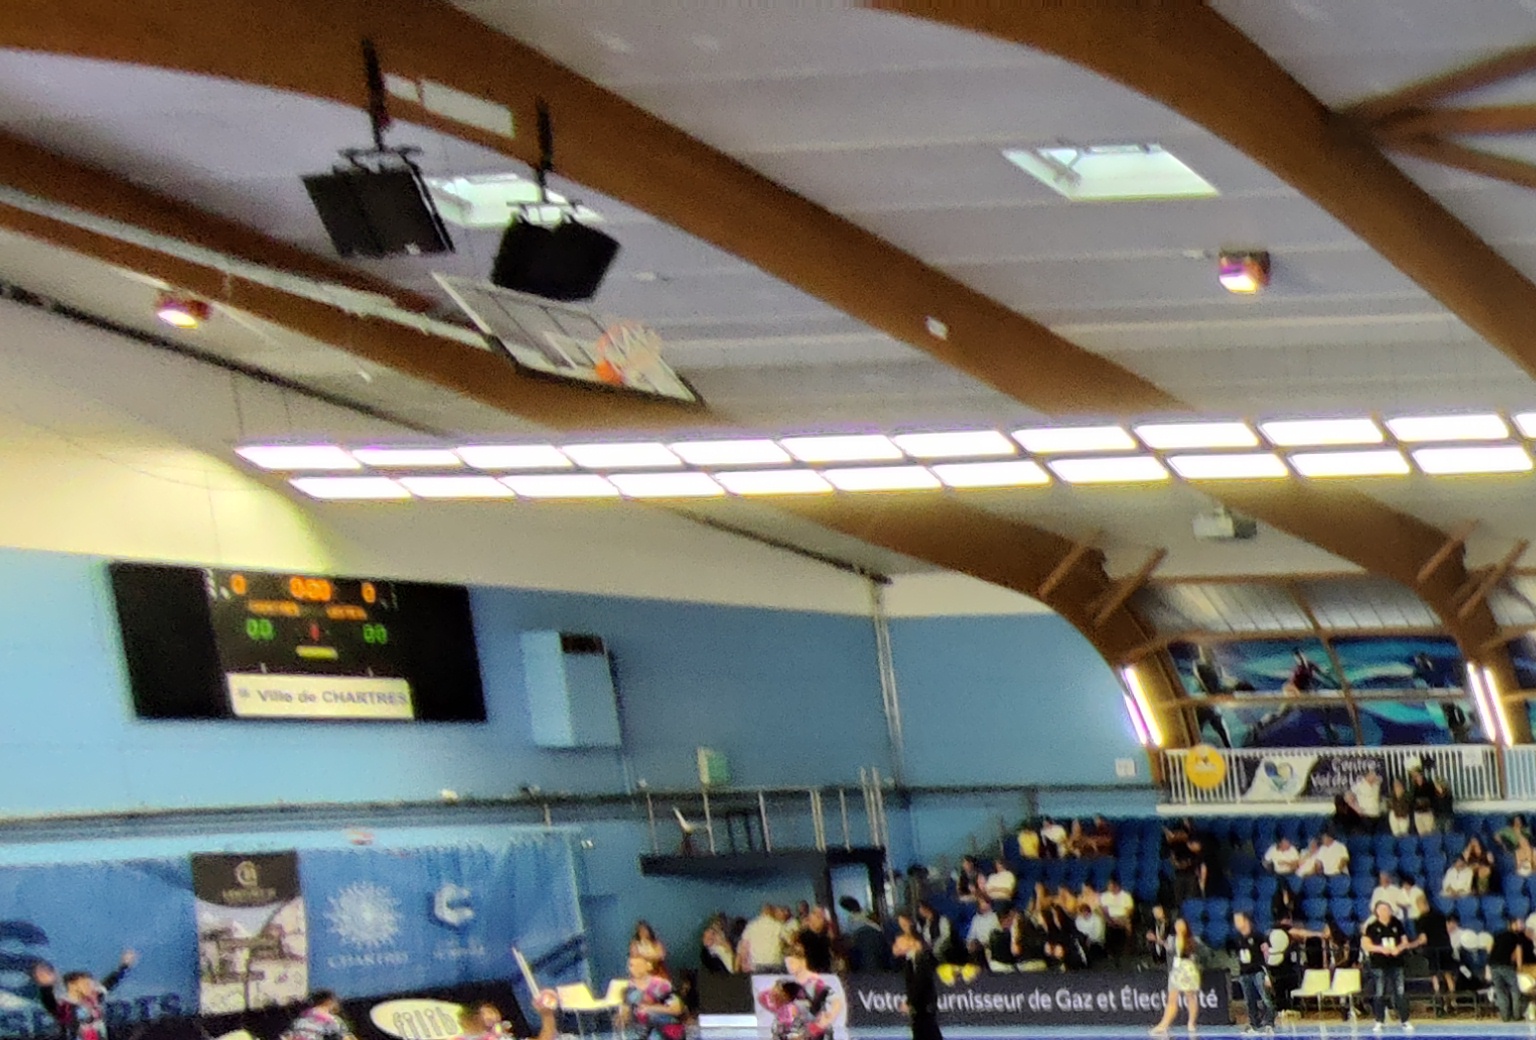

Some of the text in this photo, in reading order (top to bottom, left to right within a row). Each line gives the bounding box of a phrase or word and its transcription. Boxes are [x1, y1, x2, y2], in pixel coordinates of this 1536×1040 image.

[257, 689, 411, 705] Ville de CHARTRES
[858, 988, 908, 1012] Votr
[936, 988, 1024, 1012] urnisseur
[1028, 987, 1051, 1011] de
[1055, 988, 1093, 1013] Gaz
[1097, 989, 1116, 1012] et
